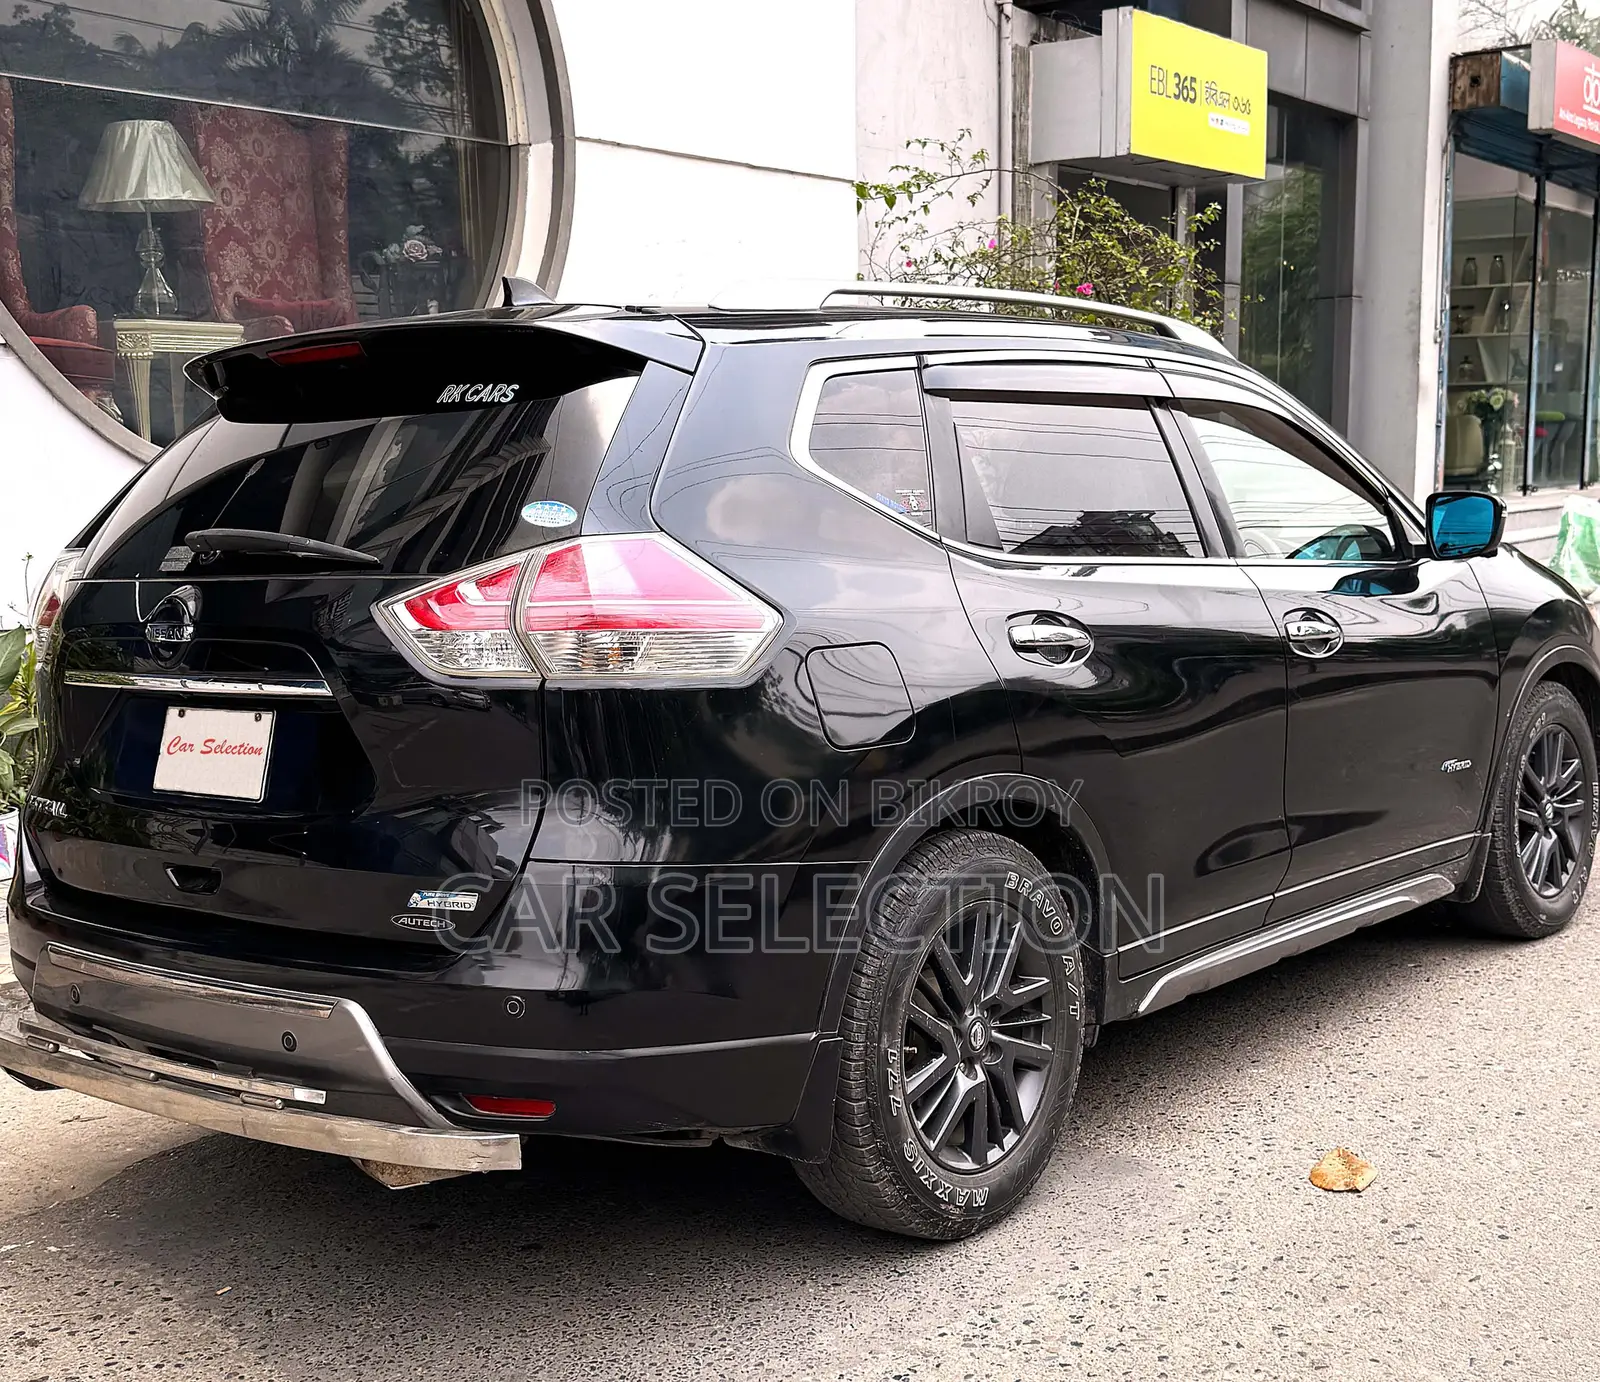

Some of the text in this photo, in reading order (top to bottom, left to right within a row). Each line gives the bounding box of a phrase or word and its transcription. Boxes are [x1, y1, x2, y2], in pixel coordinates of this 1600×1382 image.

[1233, 96, 1251, 115] ৩৬৫
[436, 383, 520, 404] RK CARS
[166, 735, 264, 756] Car Selection
[427, 899, 472, 909] HYBRID
[1005, 871, 1064, 936] BRAVO
[398, 917, 446, 928] AUTECH
[1062, 955, 1080, 1021] A/T
[903, 1138, 990, 1207] MAXXIS
